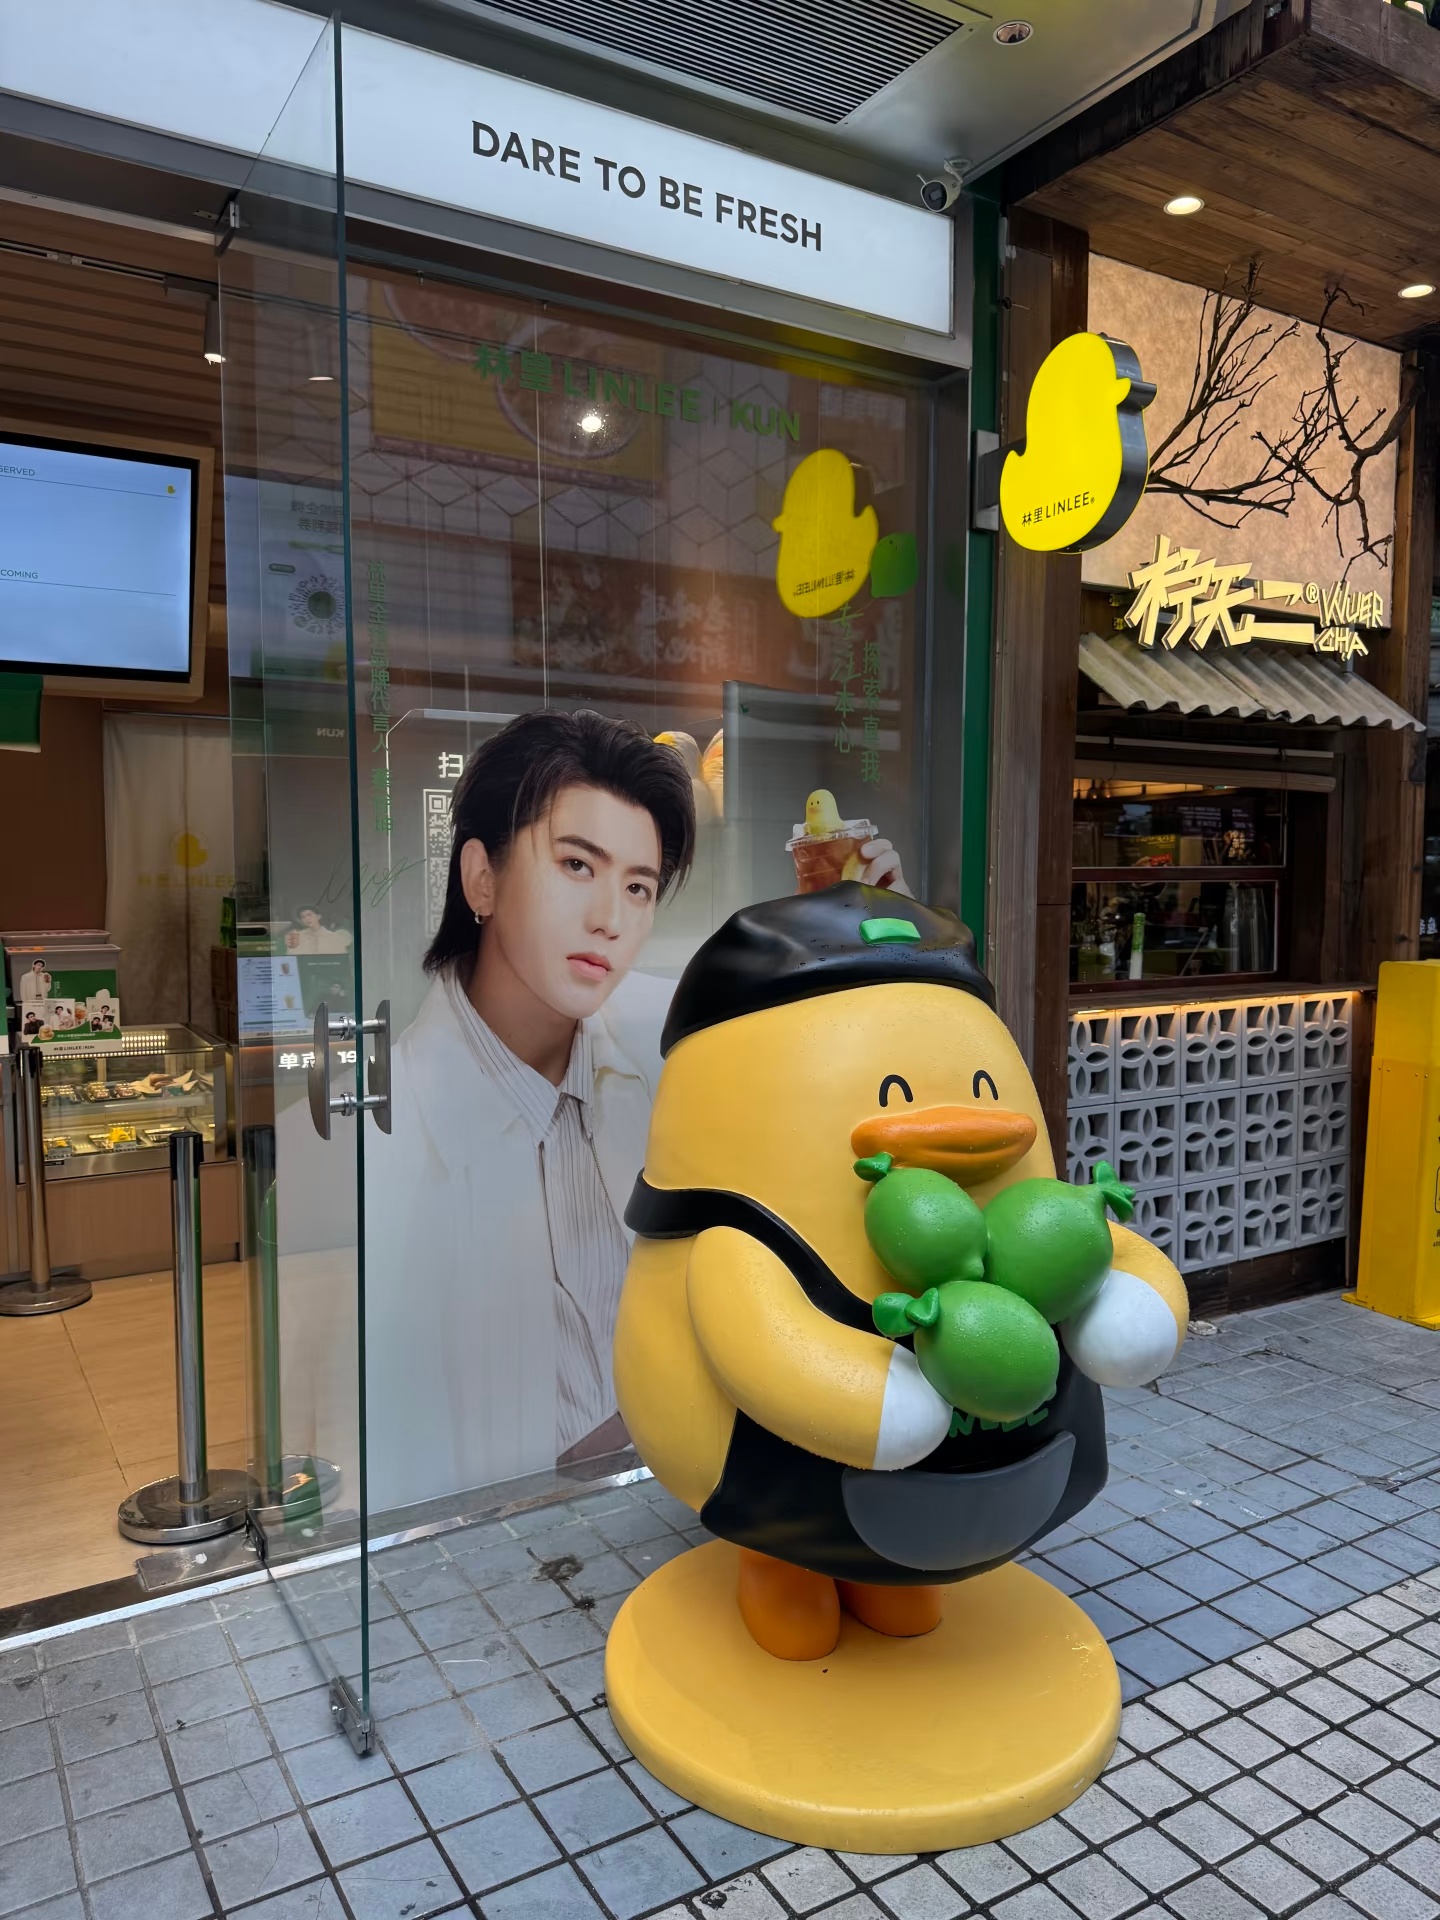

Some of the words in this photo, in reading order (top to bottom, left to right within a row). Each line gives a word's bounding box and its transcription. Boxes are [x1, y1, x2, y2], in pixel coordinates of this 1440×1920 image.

[472, 120, 581, 183] DARE
[593, 156, 646, 199] TO
[659, 175, 703, 218] BE
[715, 192, 822, 252] FRESH
[473, 343, 554, 393] 林里
[562, 360, 704, 424] LINLEE
[730, 398, 800, 442] KUN
[1021, 506, 1043, 528] 林里
[1319, 580, 1384, 629] WUER
[1314, 626, 1370, 662] CHA
